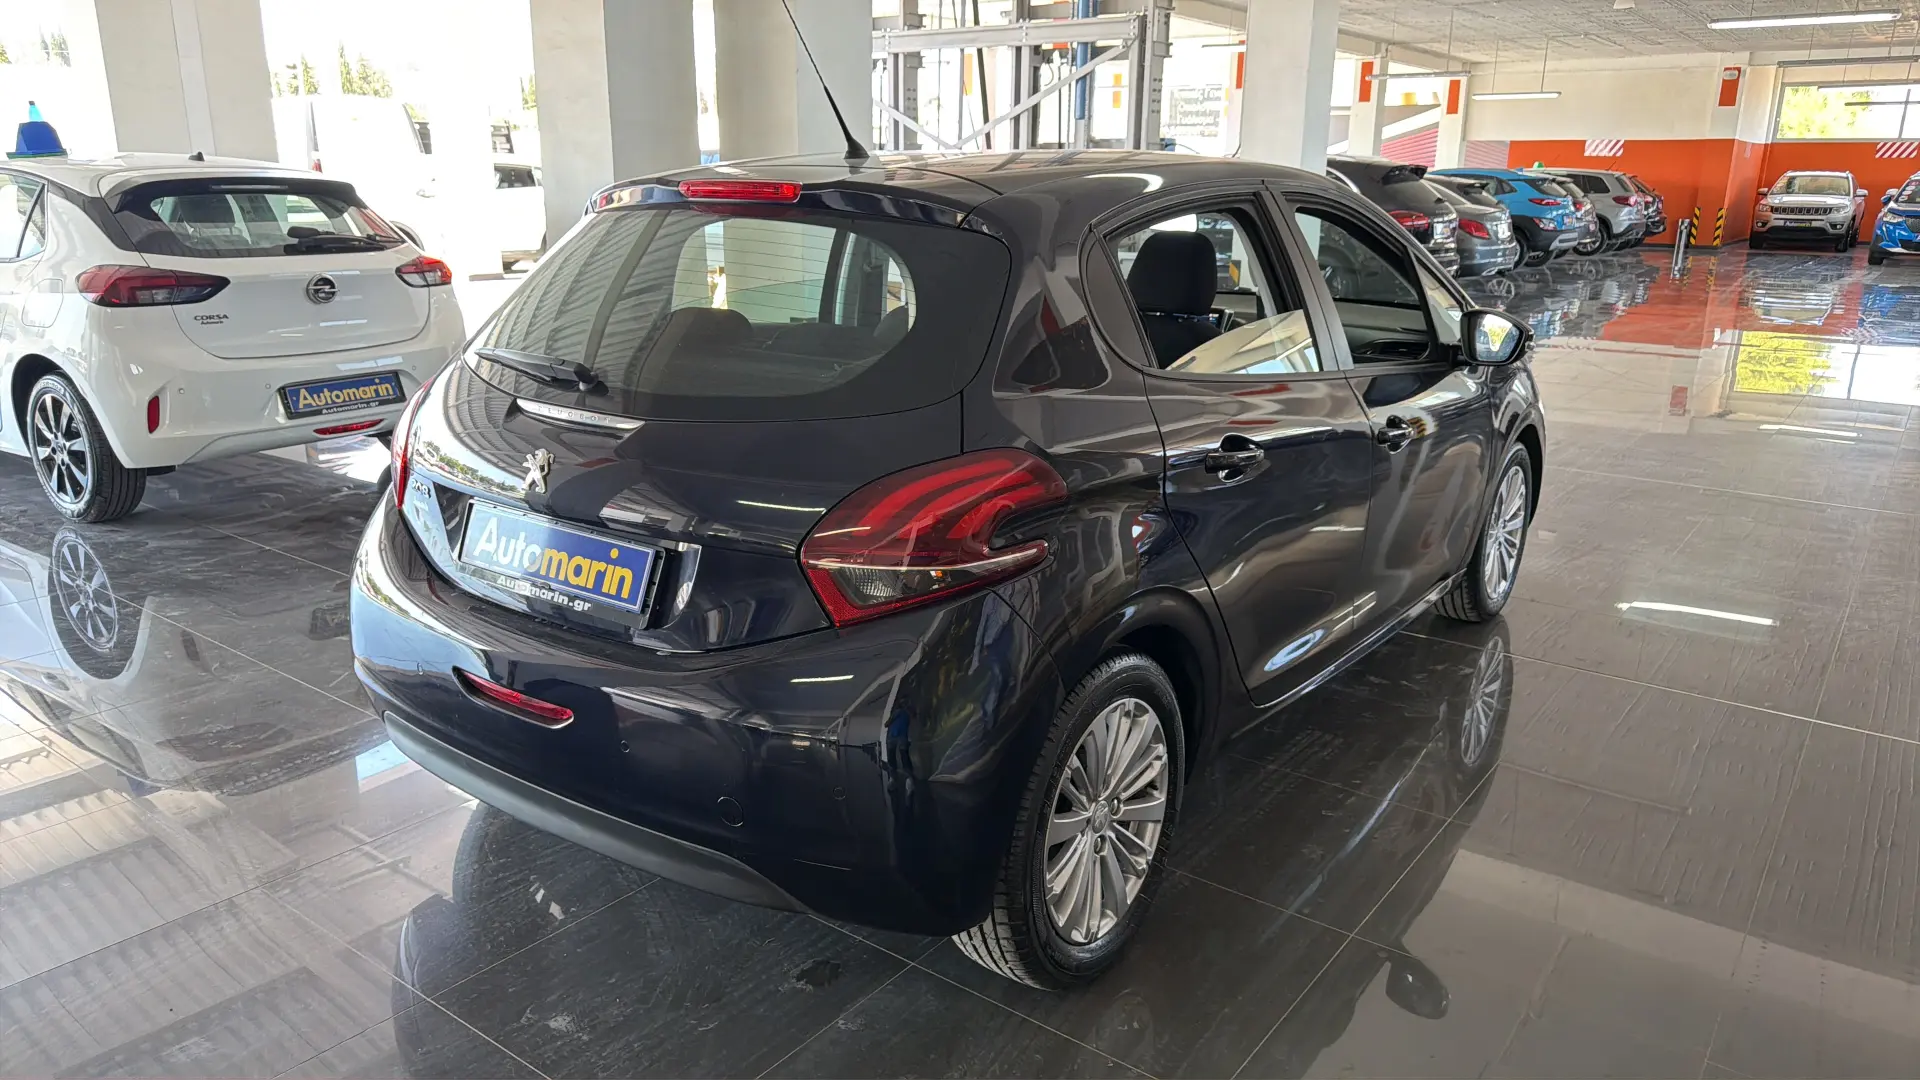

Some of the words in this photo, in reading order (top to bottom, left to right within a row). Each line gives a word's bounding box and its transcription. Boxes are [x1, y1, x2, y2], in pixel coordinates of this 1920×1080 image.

[298, 378, 394, 409] Automarin
[322, 401, 380, 415] Automarin.gr
[537, 405, 611, 424] PEUGEOT
[411, 478, 431, 499] 208
[473, 516, 633, 599] Automarin
[496, 574, 592, 612] Automarin.gr
